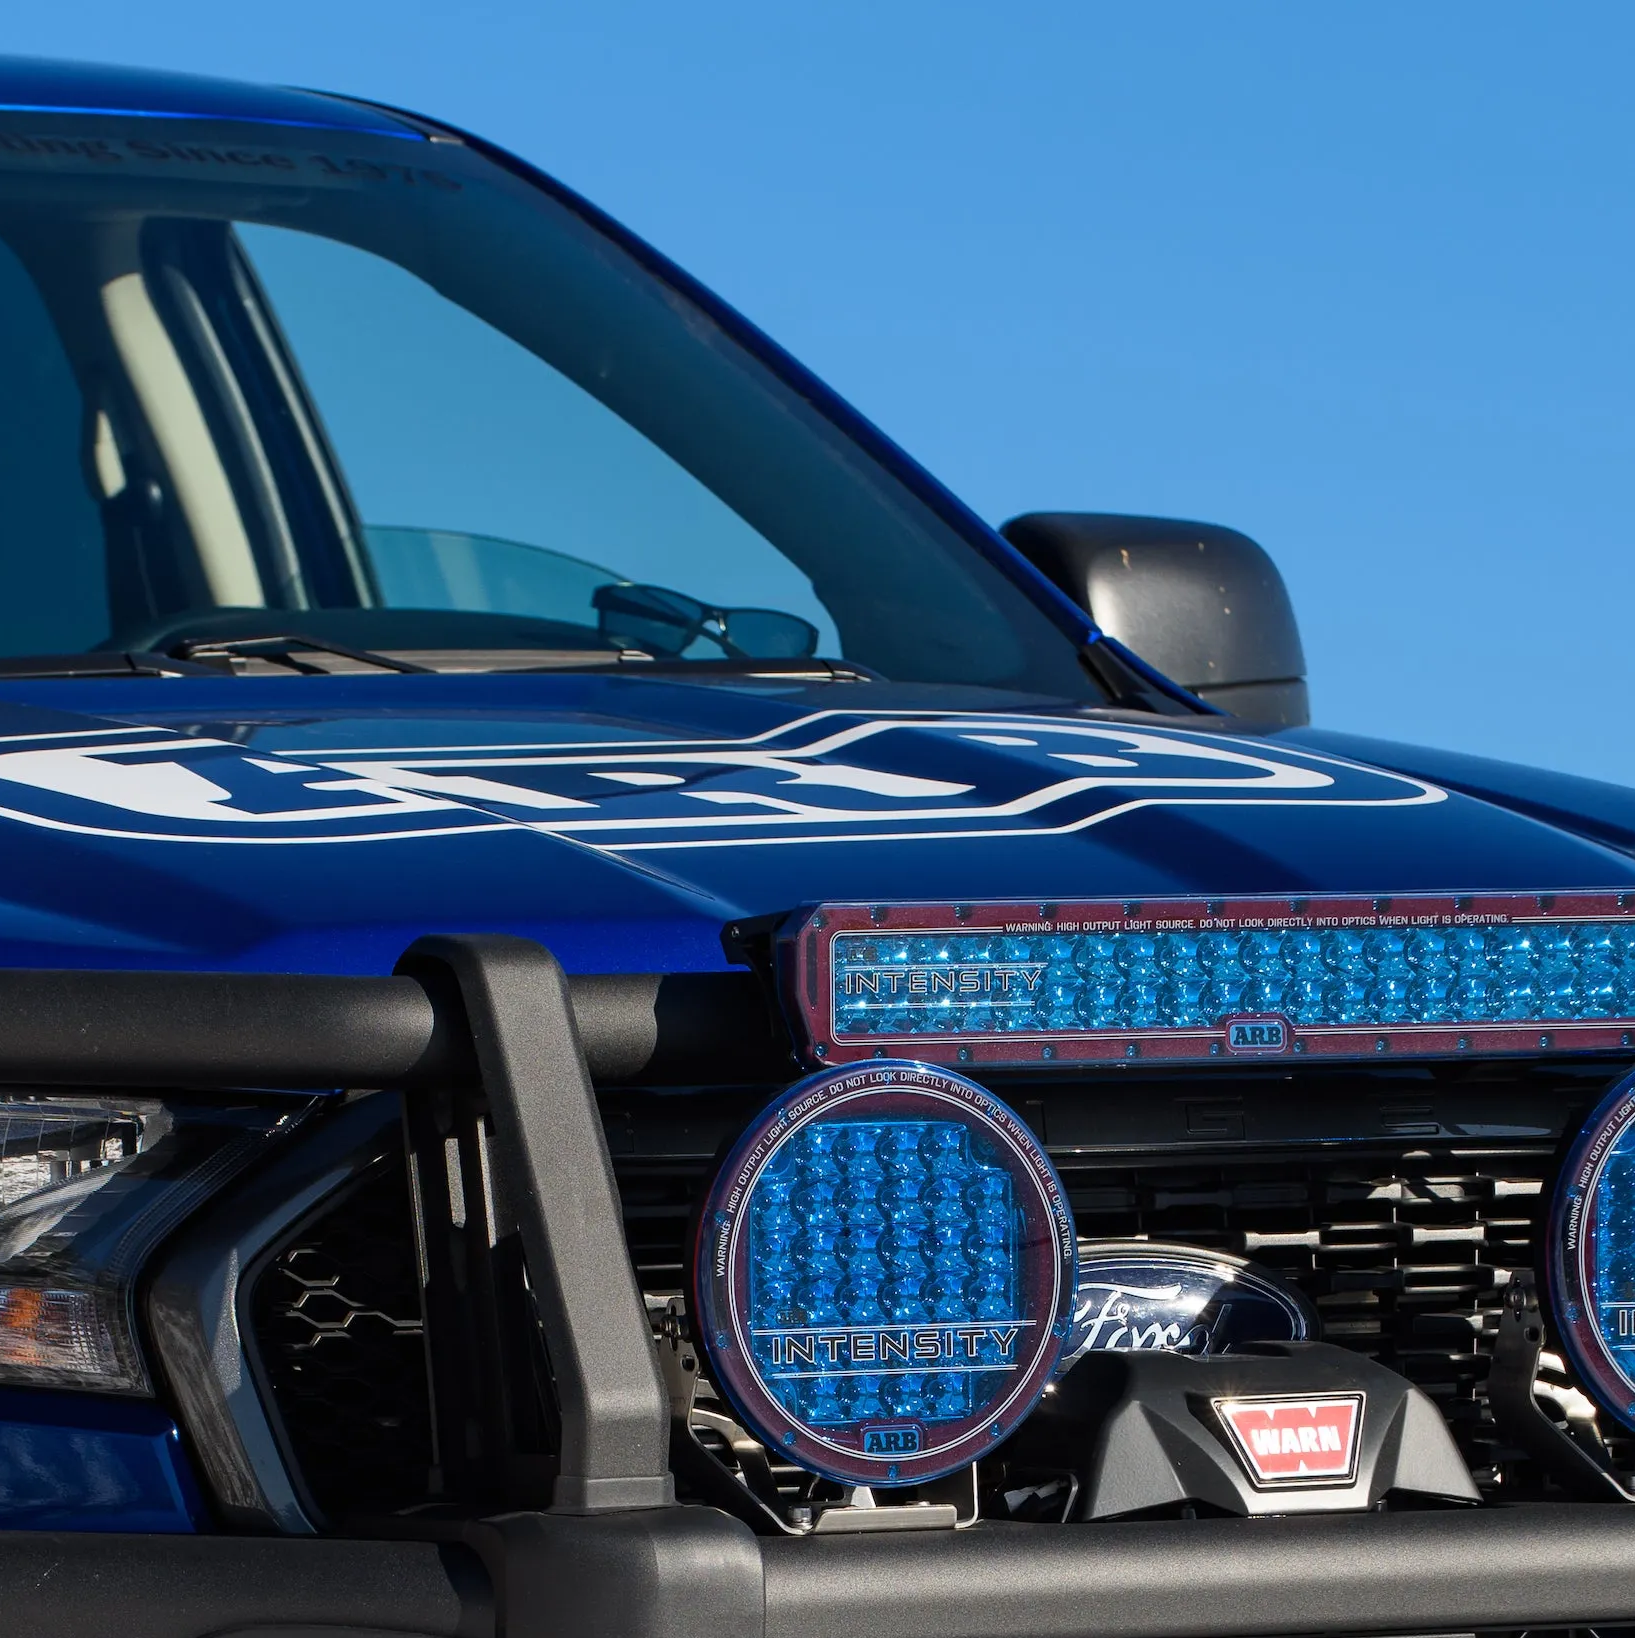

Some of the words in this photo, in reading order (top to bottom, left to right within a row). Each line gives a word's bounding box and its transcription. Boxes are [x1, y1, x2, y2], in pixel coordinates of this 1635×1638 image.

[125, 138, 297, 171] Since
[1006, 922, 1053, 933] WARNING:
[1056, 921, 1080, 932] HIGH
[1082, 921, 1121, 931] OUTPUT
[1124, 920, 1153, 931] LIGHT
[1155, 918, 1197, 930] SOURCE.
[1199, 918, 1214, 929] DO
[1214, 917, 1235, 929] NOT
[1238, 917, 1264, 928] LOOK
[1267, 916, 1313, 928] DIRECTLY
[1316, 916, 1339, 927] INTO
[1341, 915, 1376, 926] OPTICS
[1379, 915, 1409, 926] WHEN
[1411, 914, 1438, 925] LIGHT
[1441, 914, 1451, 924] IS
[1454, 913, 1510, 925] OPERATING.
[844, 969, 1042, 995] INTENSITY
[1233, 1026, 1281, 1046] ARB
[1578, 1162, 1594, 1189] HIGH
[1589, 1122, 1616, 1161] OUTPUT
[716, 1219, 731, 1278] WARNING:
[726, 1186, 742, 1214] HIGH
[738, 1143, 765, 1186] OUTPUT
[763, 1116, 790, 1147] LIGHT
[787, 1089, 828, 1120] SOURCE.
[829, 1082, 844, 1096] DO
[845, 1074, 866, 1089] NOT
[869, 1071, 897, 1083] LOOK
[900, 1071, 949, 1089] DIRECTLY
[950, 1081, 974, 1100] INTO
[974, 1094, 1007, 1123] OPTICS
[1007, 1119, 1034, 1151] WHEN
[1029, 1149, 1052, 1179] LIGHT
[1046, 1180, 1057, 1194] IS
[1052, 1193, 1073, 1260] OPERATING.
[772, 1327, 1019, 1365] INTENSITY
[865, 1429, 919, 1454] ARB
[1251, 1424, 1343, 1457] WARN
